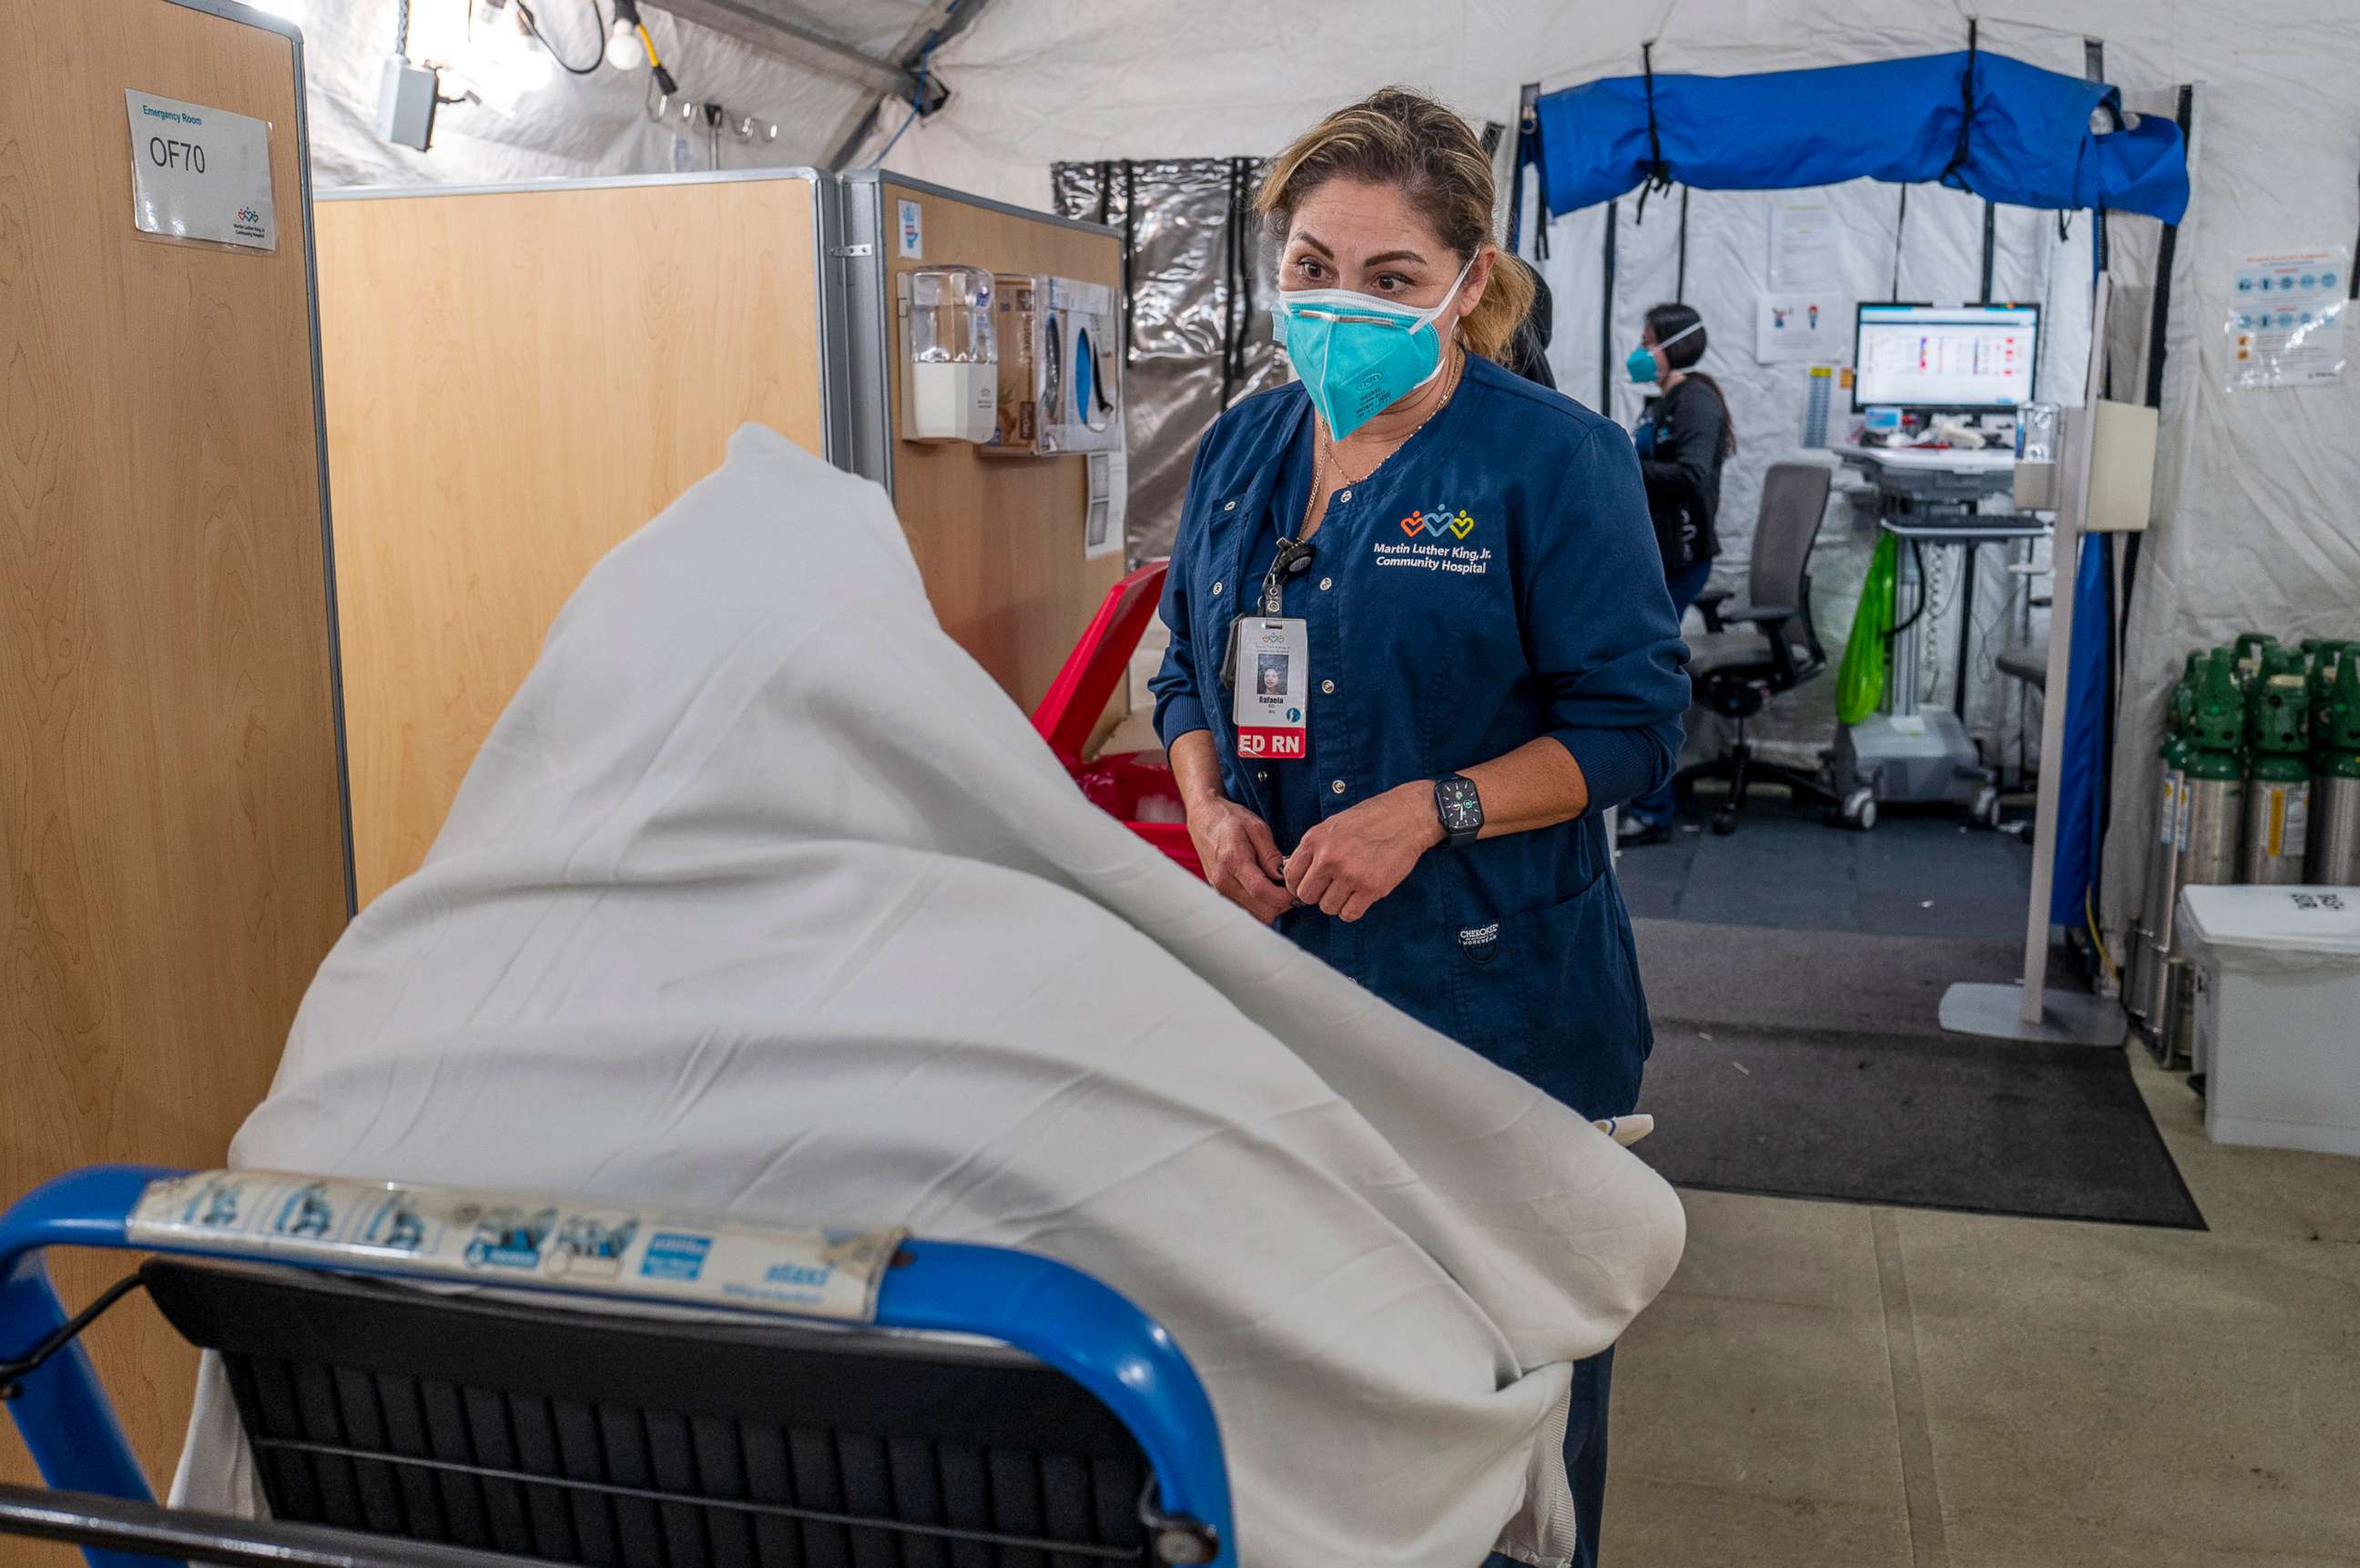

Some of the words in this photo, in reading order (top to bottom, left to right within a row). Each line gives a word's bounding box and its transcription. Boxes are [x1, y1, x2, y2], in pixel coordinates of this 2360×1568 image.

[142, 105, 181, 124] Emergency
[181, 113, 202, 126] Room
[150, 137, 206, 174] OF70
[1373, 543, 1410, 554] Martin
[1412, 544, 1450, 556] Luther
[1451, 546, 1479, 561] King,
[1480, 548, 1491, 559] Jr.
[1376, 556, 1439, 571] Community
[1441, 560, 1486, 575] Hospital
[1258, 696, 1284, 704] Rafaela
[1239, 735, 1266, 752] ED
[1271, 735, 1300, 754] RN
